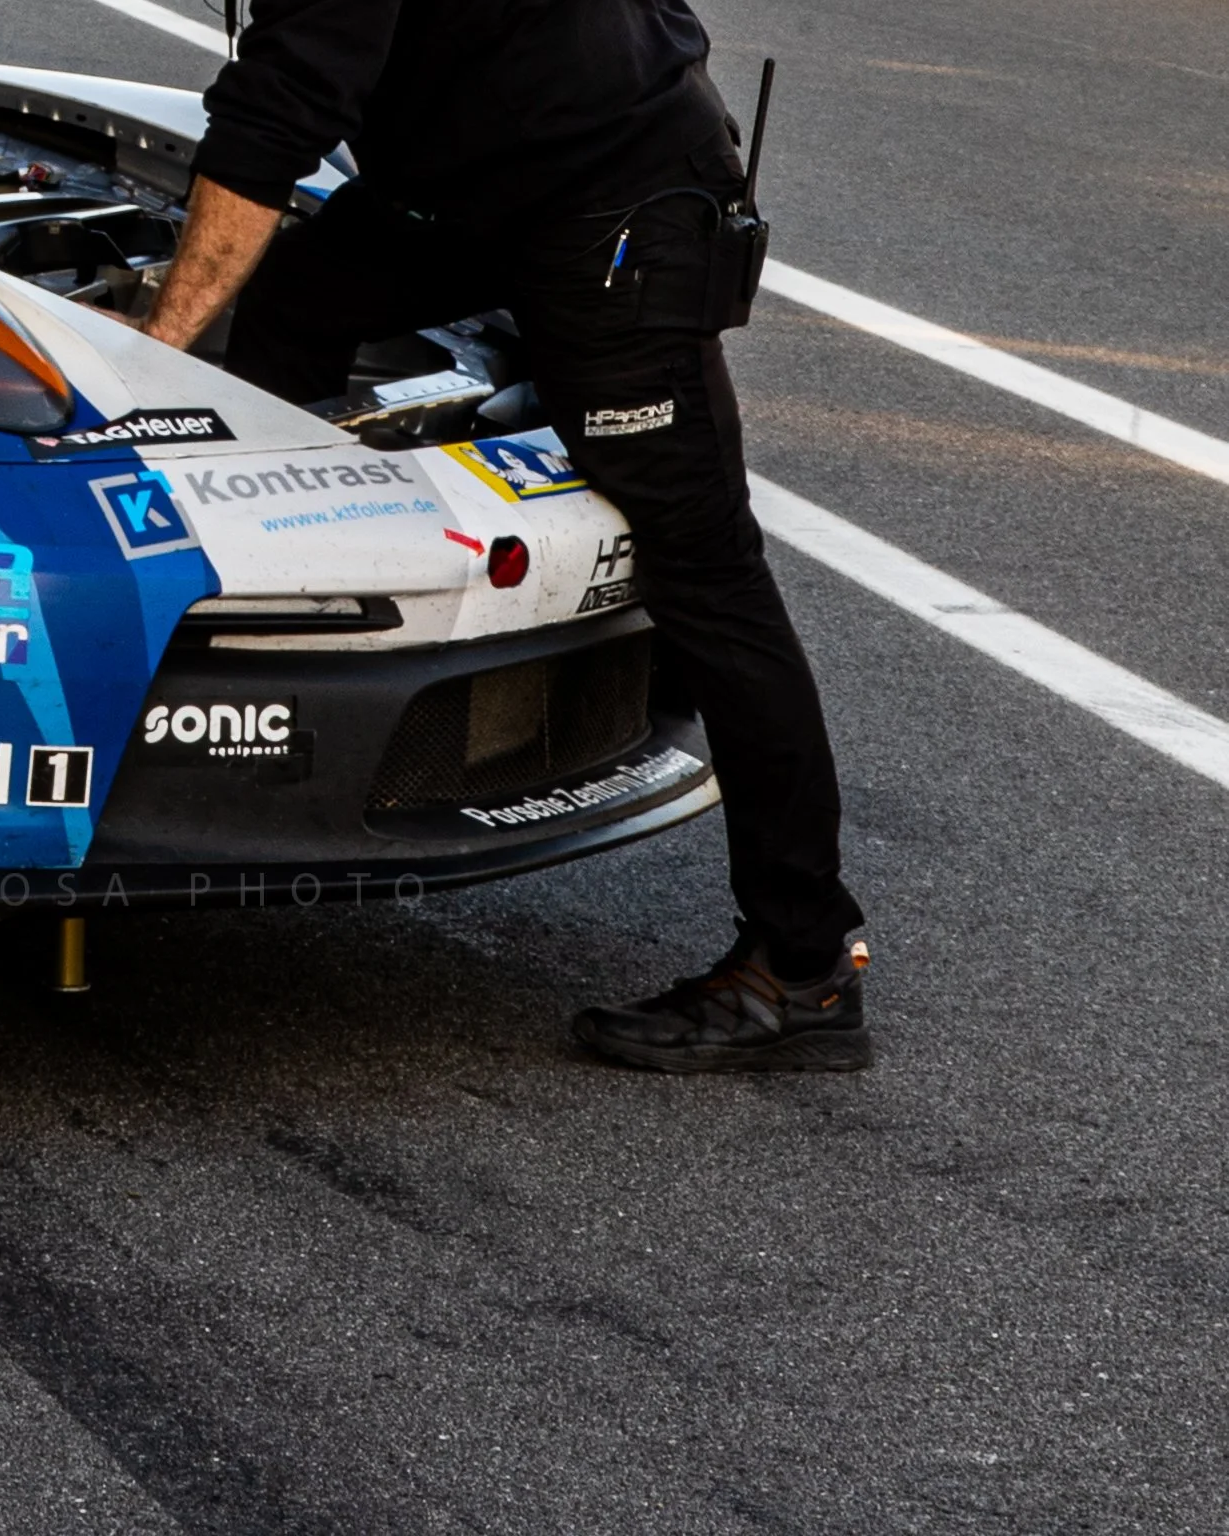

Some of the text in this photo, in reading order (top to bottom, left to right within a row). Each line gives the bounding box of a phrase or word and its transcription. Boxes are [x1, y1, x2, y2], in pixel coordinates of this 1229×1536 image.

[184, 457, 415, 505] Kontrast
[260, 497, 439, 533] www.ktfolien.de
[208, 745, 290, 758] equipment
[46, 752, 70, 801] 1
[459, 774, 641, 827] Porsche Zentrum
